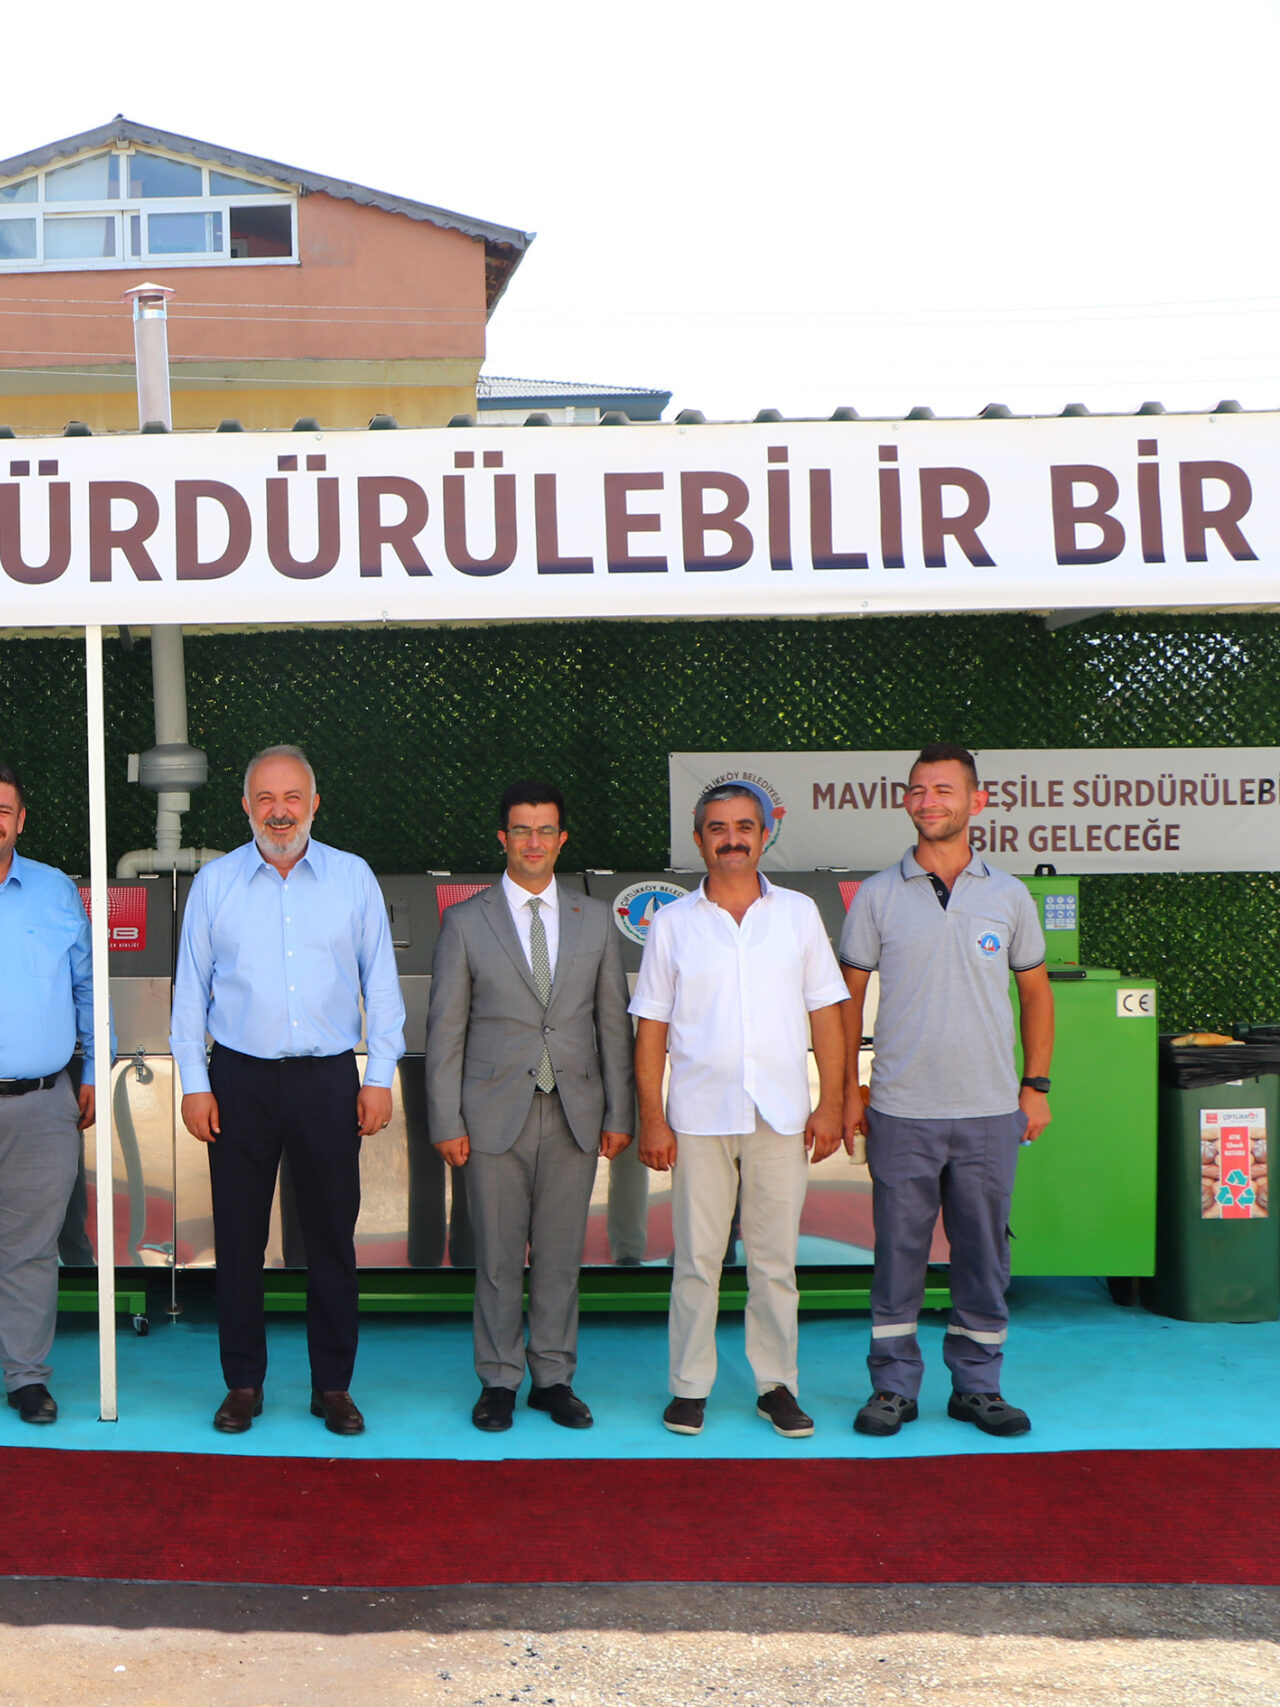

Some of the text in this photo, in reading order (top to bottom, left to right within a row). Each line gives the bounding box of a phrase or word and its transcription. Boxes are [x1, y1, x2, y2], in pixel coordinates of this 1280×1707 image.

[1050, 438, 1260, 566] BİR
[742, 772, 783, 806] BELEDİYESİ
[813, 776, 910, 810] MAVİD
[977, 775, 1064, 812] EŞİLE
[969, 818, 1181, 853] BİR GELECEĞE
[1123, 993, 1149, 1012] CE
